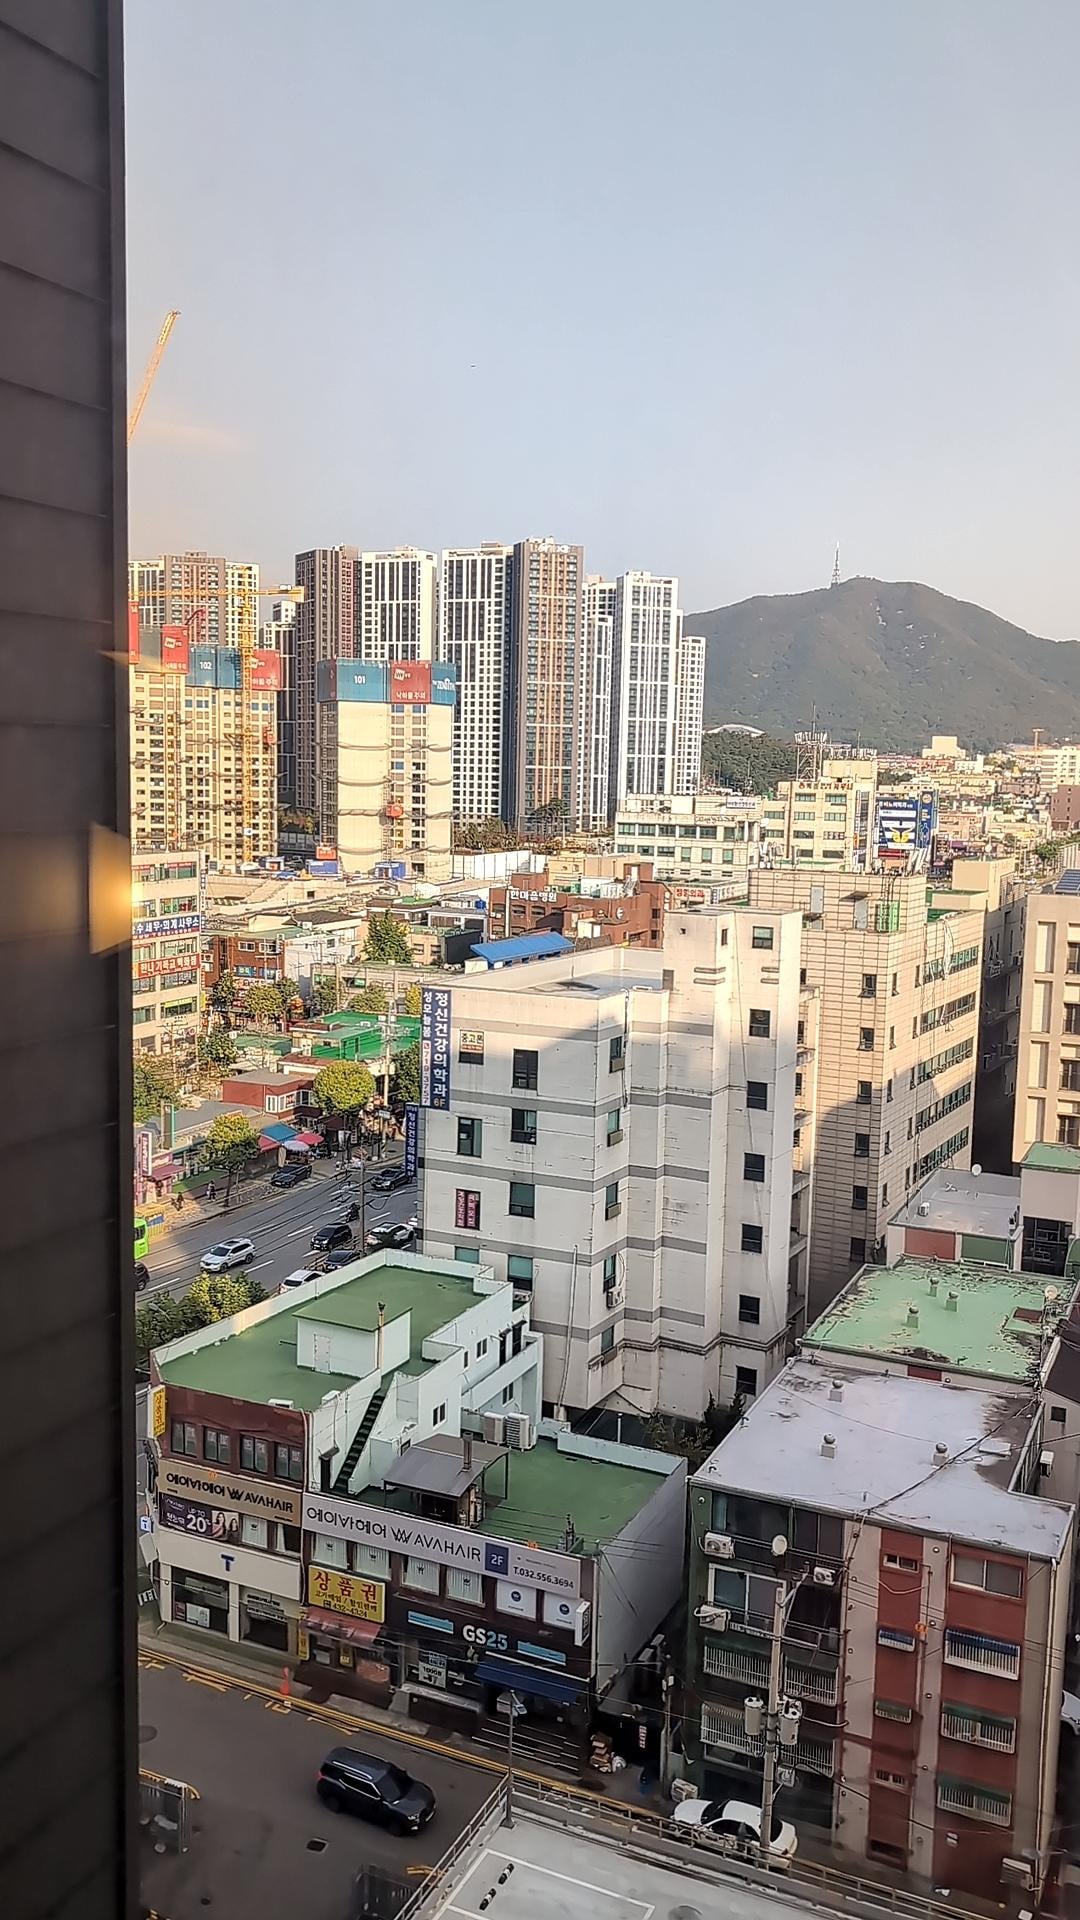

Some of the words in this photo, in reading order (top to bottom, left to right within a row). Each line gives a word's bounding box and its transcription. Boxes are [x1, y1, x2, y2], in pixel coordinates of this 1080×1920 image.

[199, 661, 212, 670] 102
[354, 675, 366, 684] 101
[433, 992, 448, 1098] 정신건강의학과
[221, 1554, 235, 1571] T
[491, 1553, 504, 1566] 2F
[314, 1571, 377, 1604] 상품권
[462, 1625, 508, 1650] GS25
